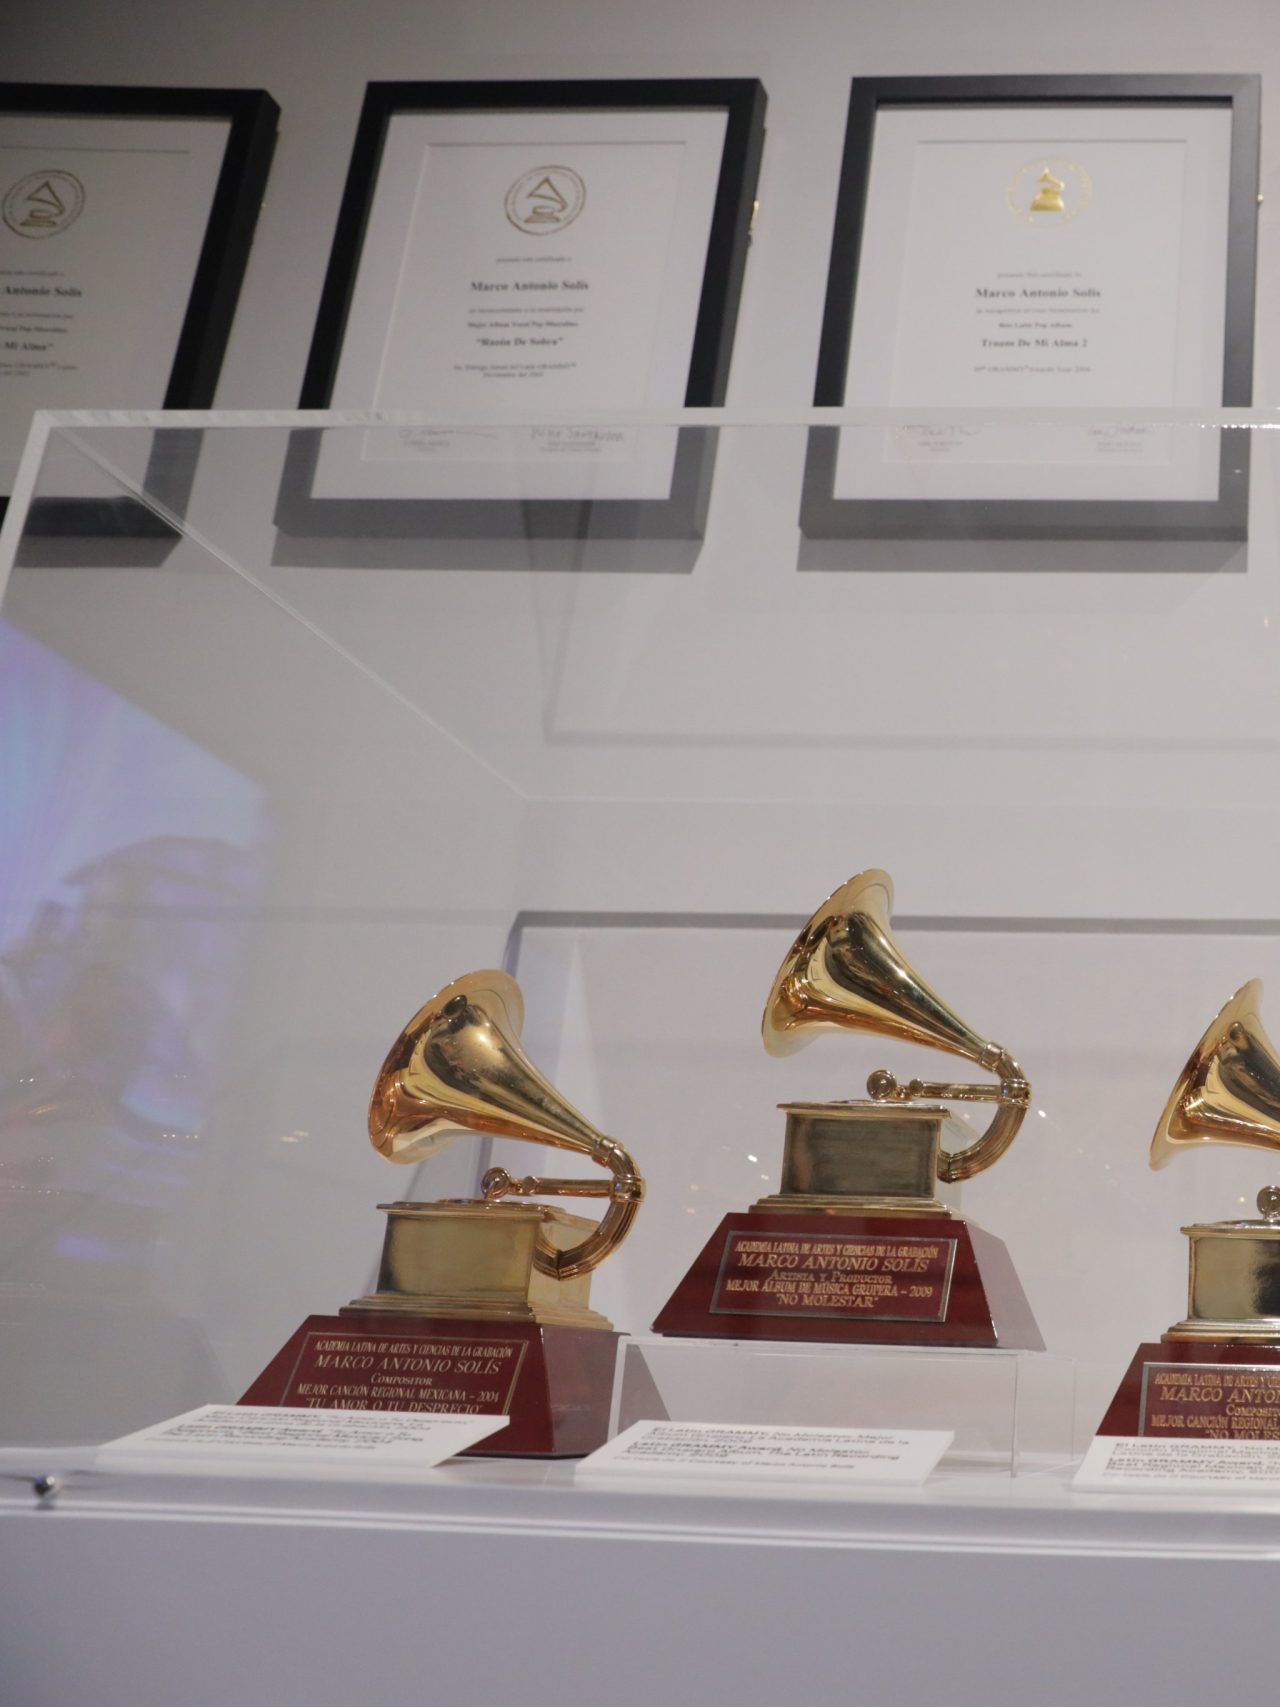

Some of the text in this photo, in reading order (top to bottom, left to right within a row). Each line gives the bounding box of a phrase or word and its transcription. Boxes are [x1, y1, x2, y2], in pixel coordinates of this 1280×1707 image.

[975, 287, 1016, 298] Marco
[1020, 287, 1069, 298] Antonio
[738, 1253, 929, 1272] MARCO ANTONIO SOLÍS
[726, 1279, 932, 1297] MEJOR ÁLBUM DE MÚSICA GRUPERA 2009
[314, 1354, 501, 1375] MARCO ANTONIO SOLÍS
[297, 1383, 500, 1403] MEJOR CANCIÓN REGIONAL MEXICANA 2004
[1160, 1386, 1222, 1402] MARCO
[1152, 1415, 1184, 1427] MEJOR
[1186, 1415, 1228, 1429] CANCIÓN
[1231, 1418, 1280, 1430] REGIONAL
